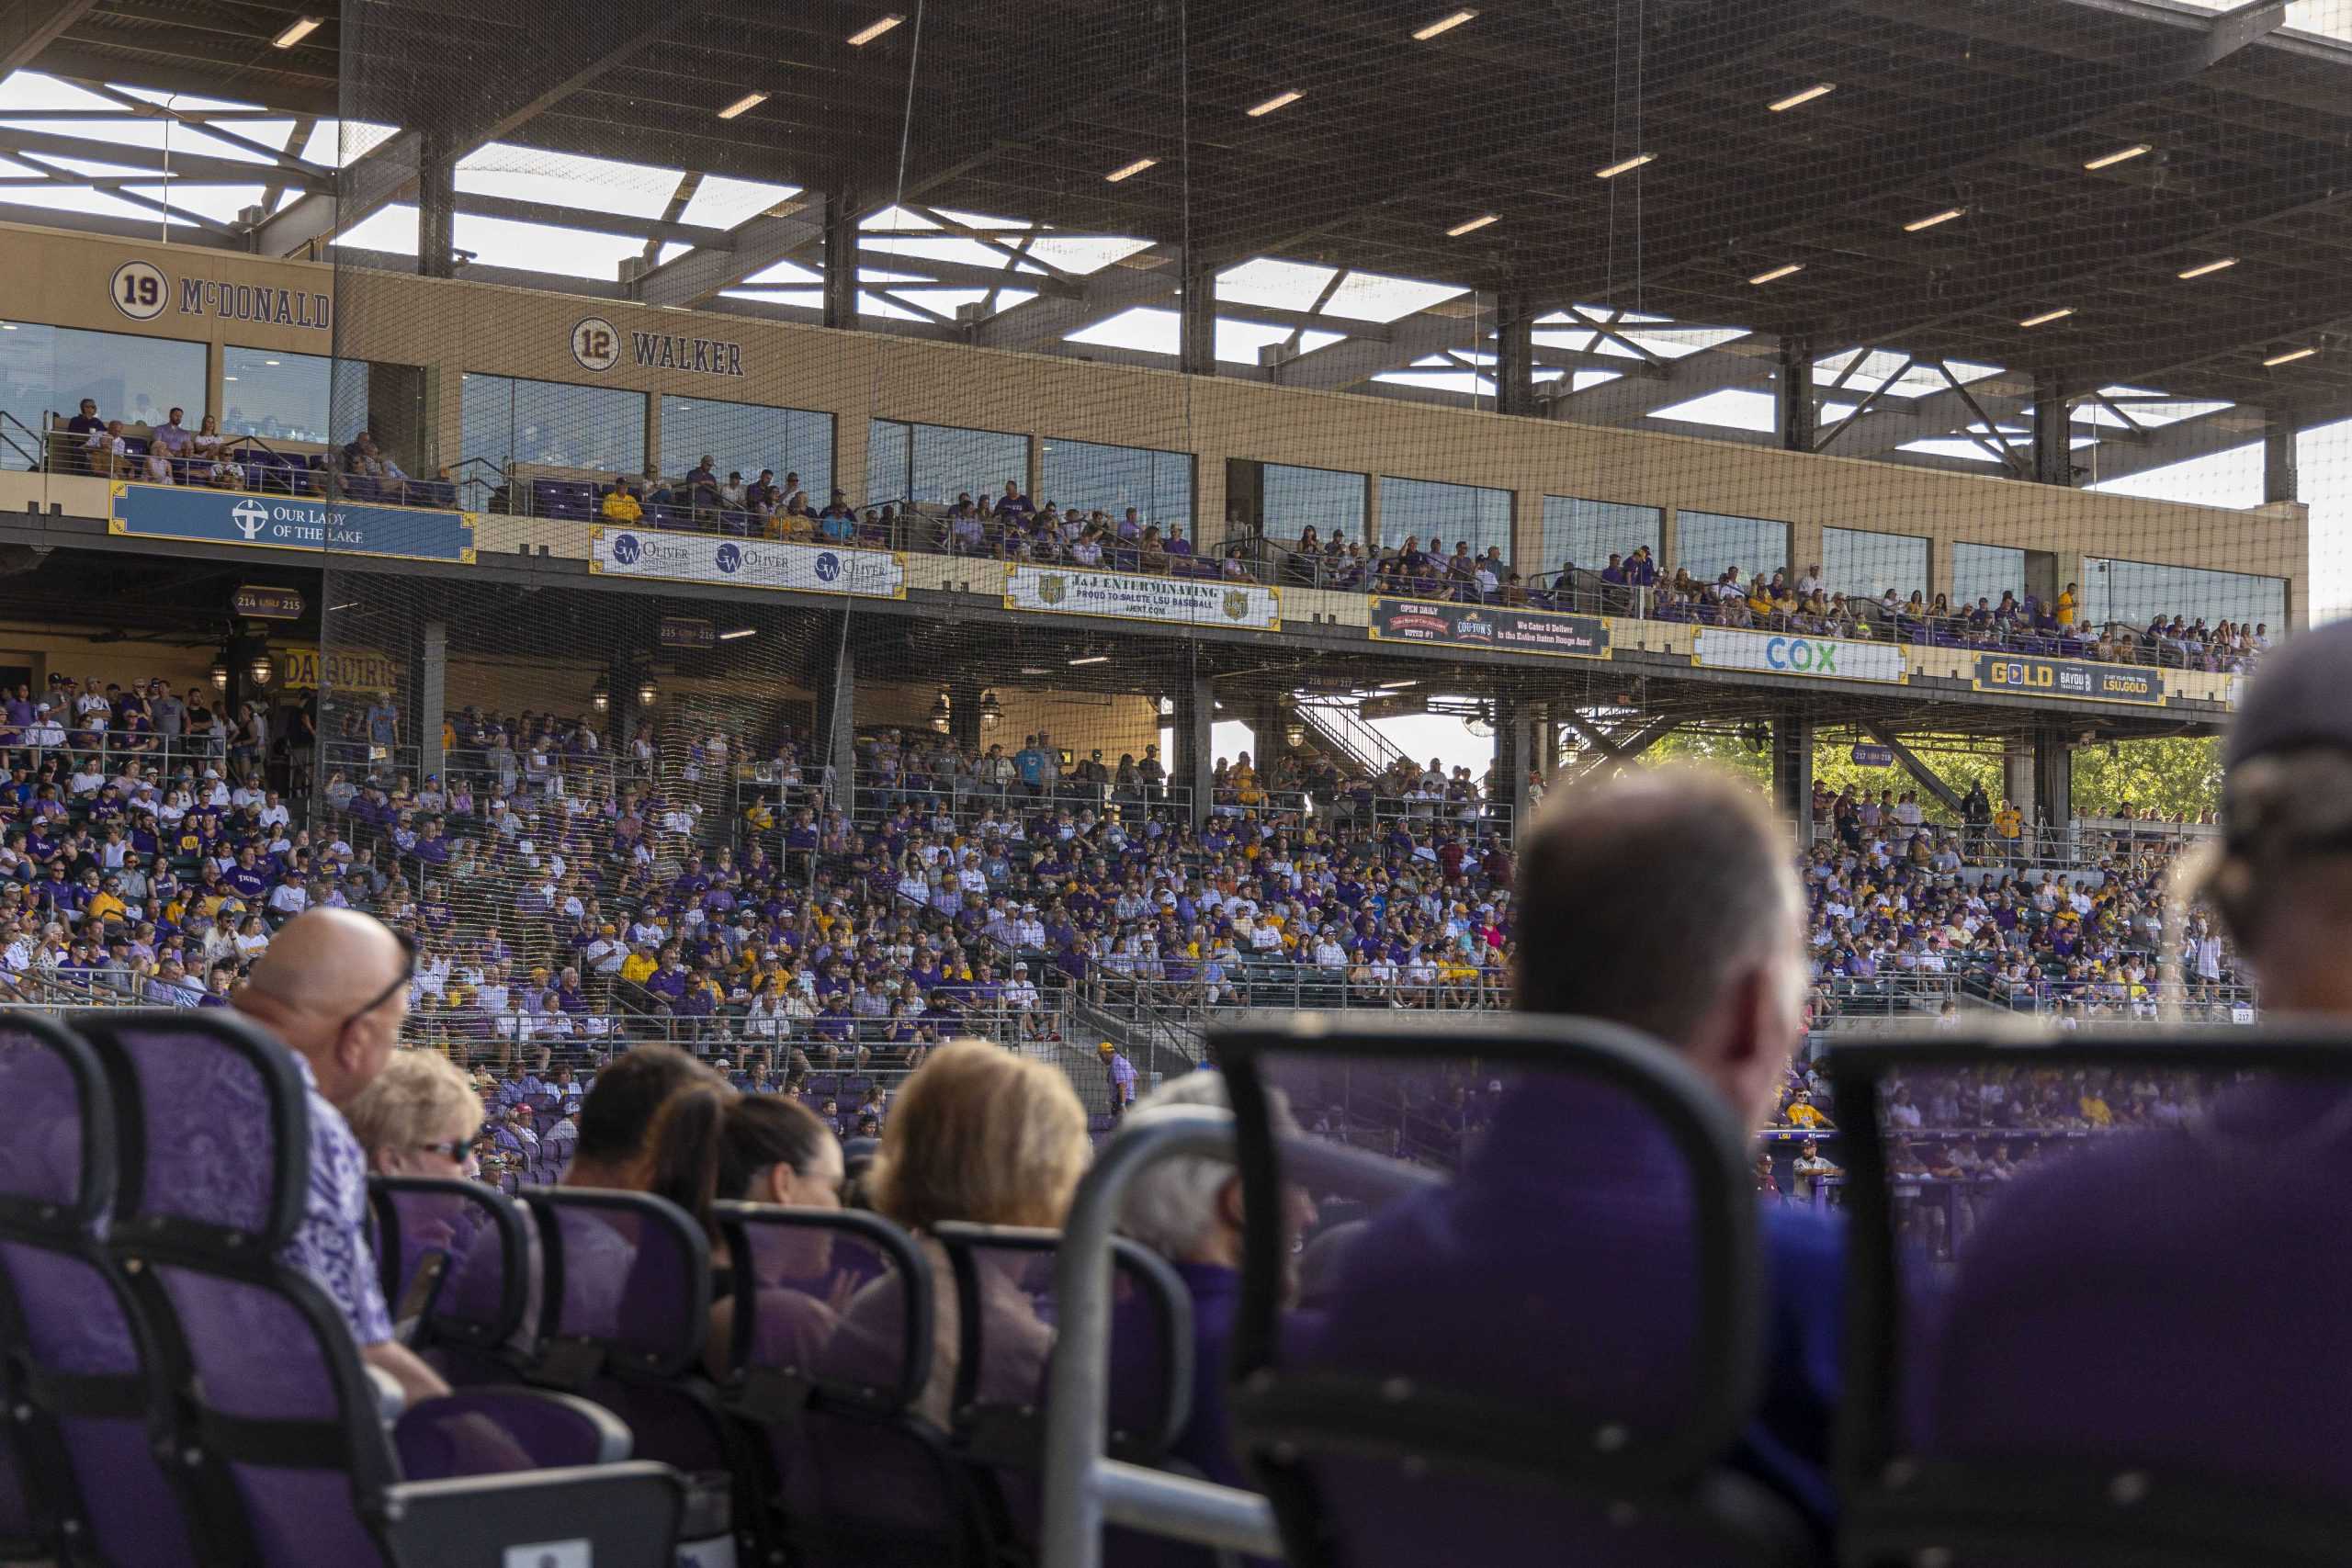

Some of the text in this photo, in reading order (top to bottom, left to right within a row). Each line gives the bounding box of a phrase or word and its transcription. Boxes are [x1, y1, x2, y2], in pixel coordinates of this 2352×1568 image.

[124, 275, 158, 306] 19
[582, 328, 744, 378] 12 WALKER
[274, 506, 346, 525] OUR LADY
[273, 525, 364, 544] OF THE LAKE
[1103, 577, 1218, 598] EXTERMINATING
[238, 596, 256, 607] 214
[282, 600, 300, 610] 215
[1077, 589, 1213, 609] PROUD TO SALUTE LSU BASEBALL
[1400, 604, 1439, 616] OPEN DAILY
[1404, 628, 1423, 637] VOTED
[1517, 621, 1527, 630] We
[1552, 624, 1573, 634] Deliver
[1766, 637, 1838, 673] COX
[2060, 671, 2085, 686] BAYOU
[2103, 680, 2148, 694] LSU.GOLD
